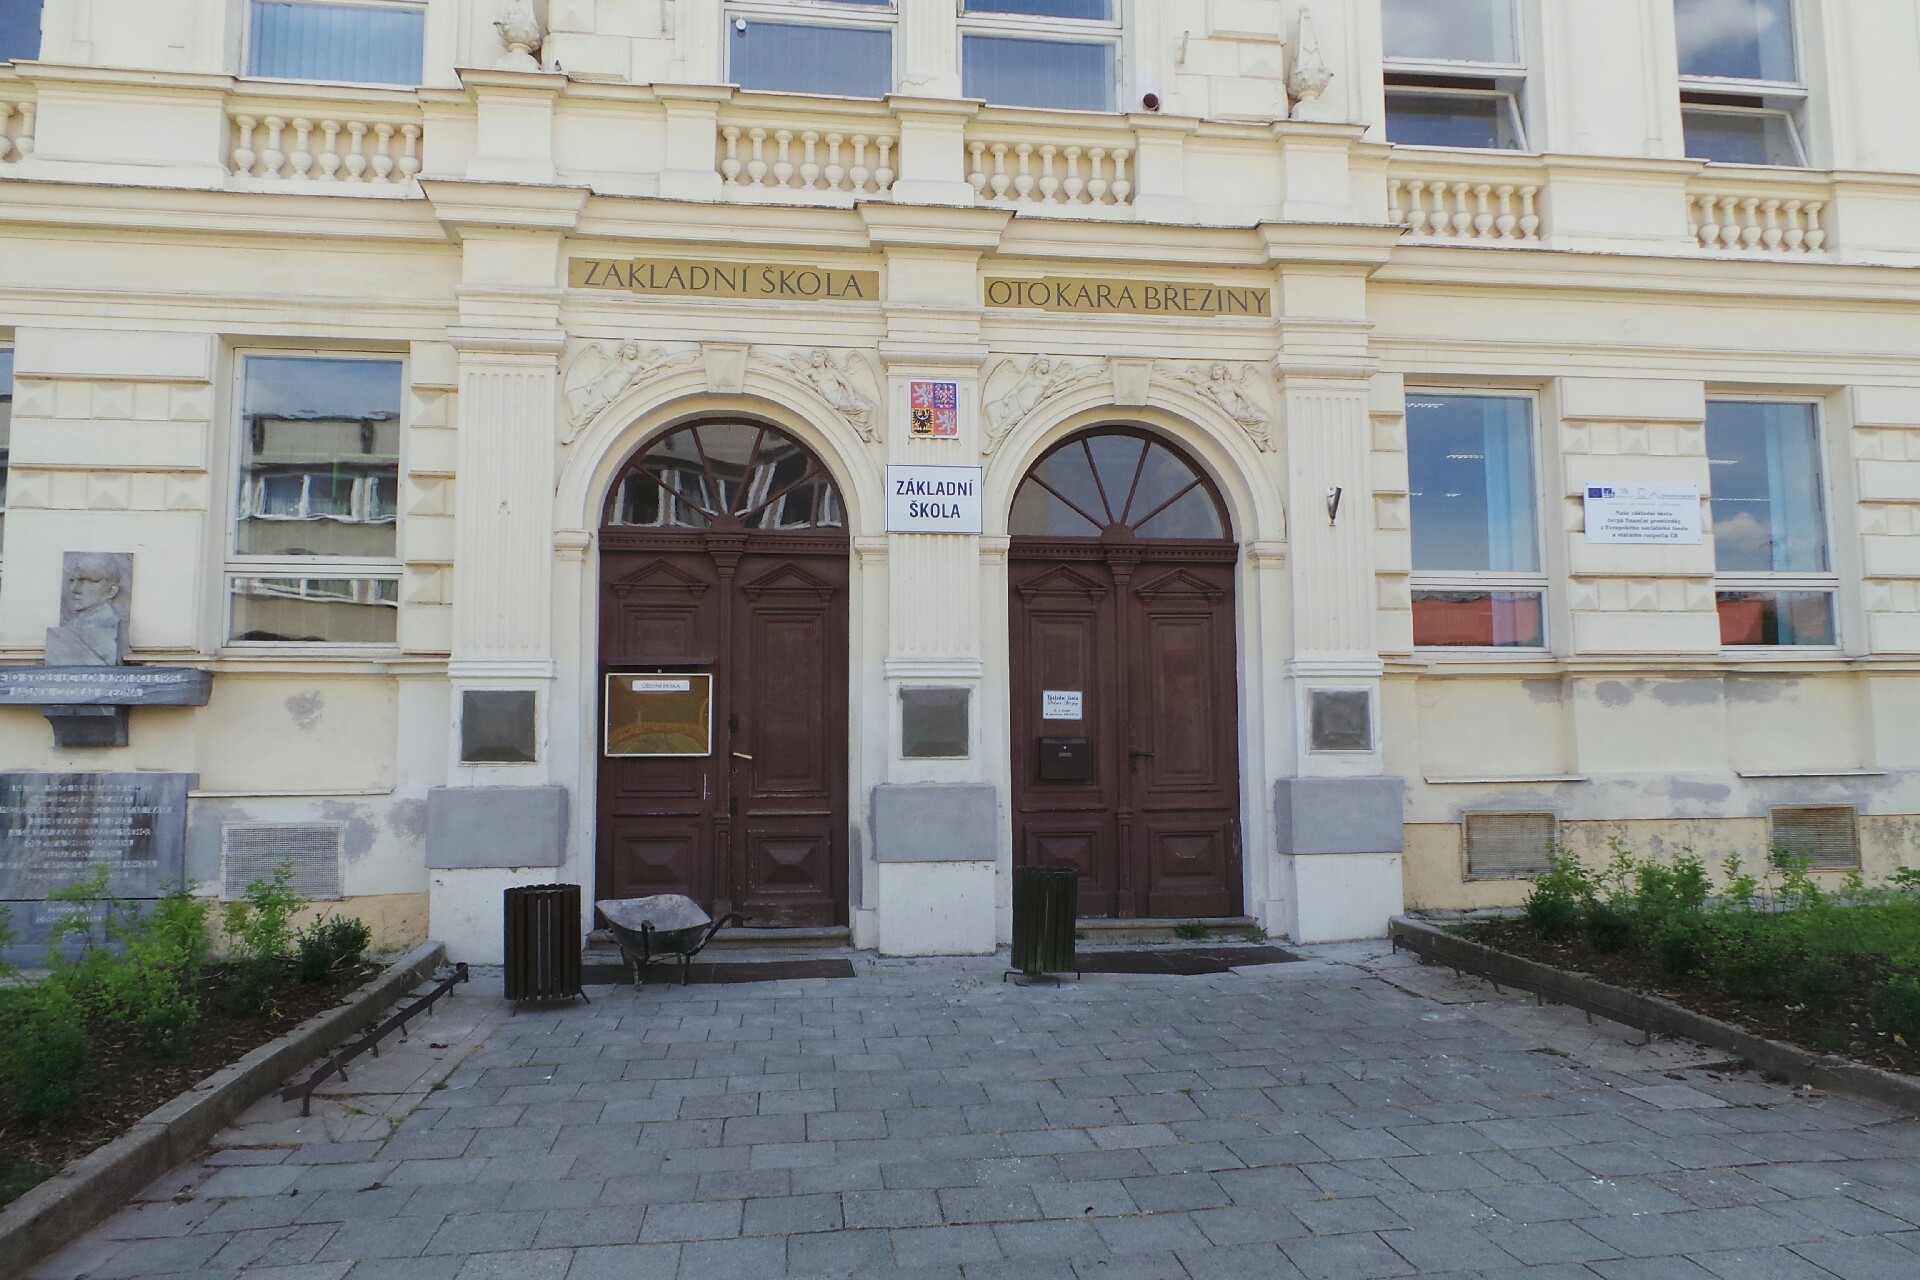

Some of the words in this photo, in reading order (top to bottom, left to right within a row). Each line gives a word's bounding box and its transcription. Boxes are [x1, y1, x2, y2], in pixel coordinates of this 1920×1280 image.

[584, 260, 750, 293] ZÁKLADNÍ
[760, 266, 864, 298] ŠKOLA
[988, 280, 1137, 309] OTOKARA
[1144, 283, 1268, 314] BŘEZINY
[896, 478, 973, 496] ZÁKLADNÍ
[909, 500, 961, 519] ŠKOLA
